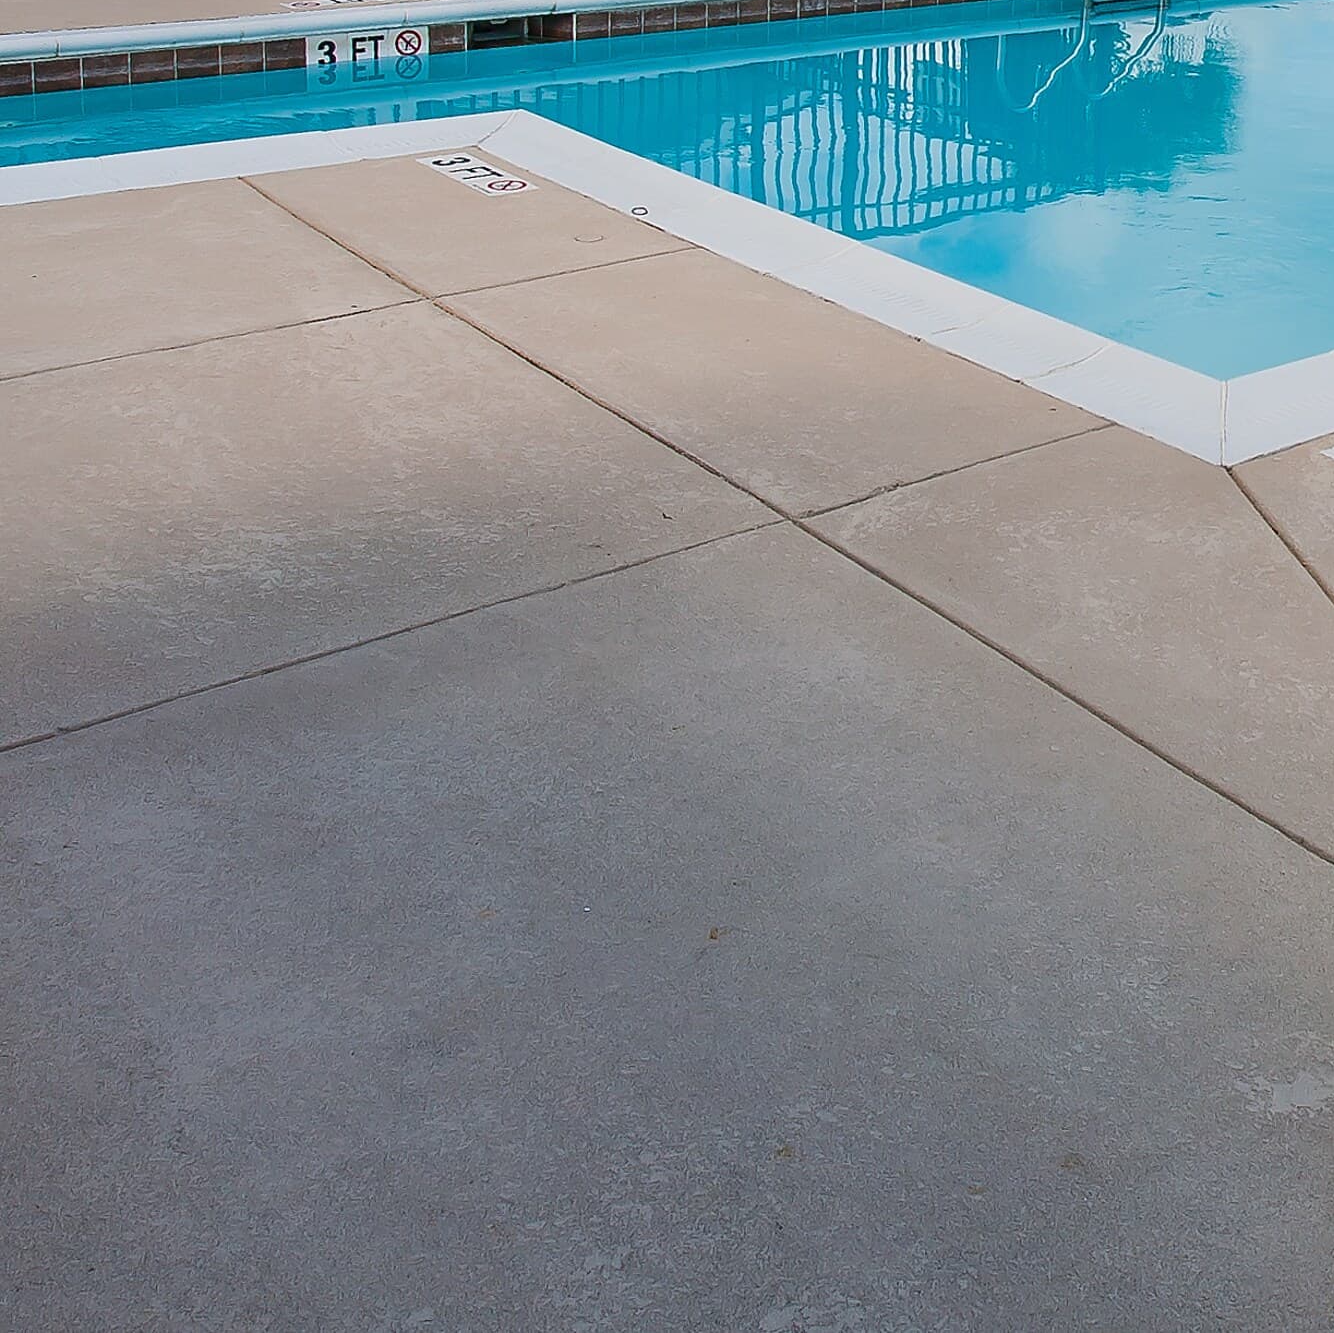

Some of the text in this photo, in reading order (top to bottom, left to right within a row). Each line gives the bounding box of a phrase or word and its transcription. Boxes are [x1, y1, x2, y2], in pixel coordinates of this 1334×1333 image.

[317, 35, 384, 65] 3 FT
[432, 156, 504, 180] 3 FT
